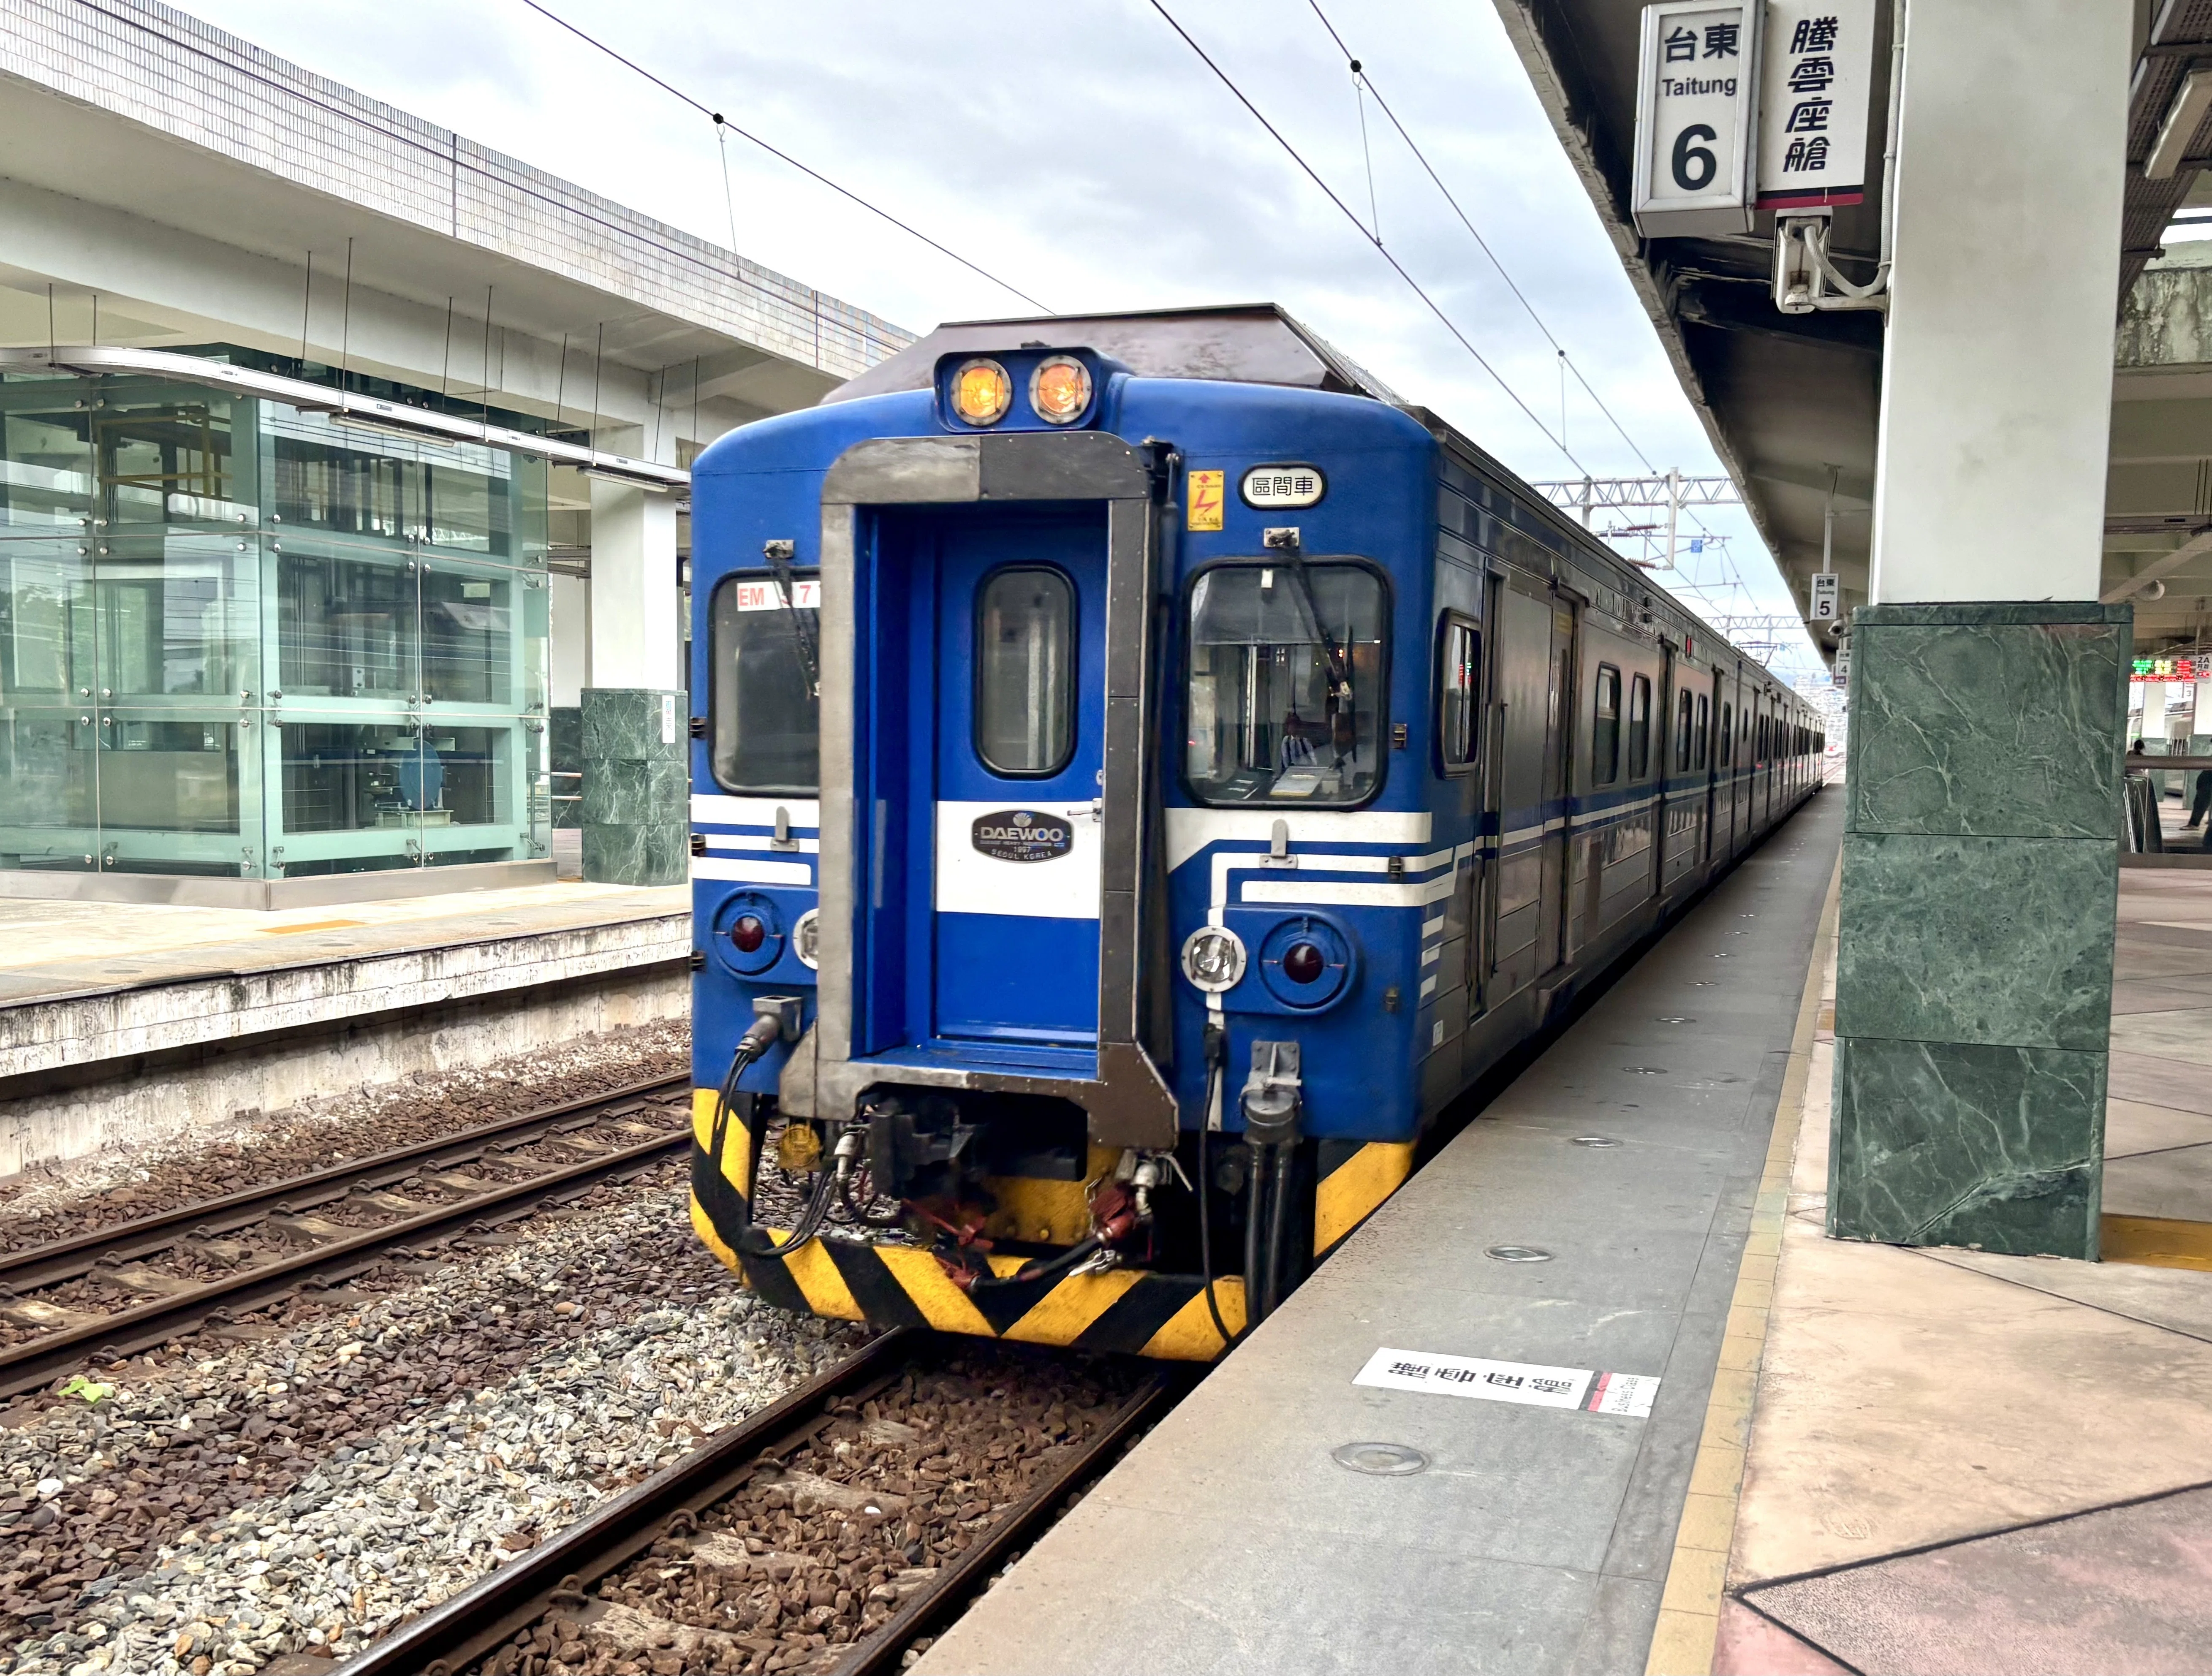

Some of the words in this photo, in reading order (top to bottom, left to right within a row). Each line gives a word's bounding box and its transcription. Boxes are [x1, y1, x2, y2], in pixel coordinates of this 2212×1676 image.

[1664, 23, 1740, 63] 台東
[1662, 77, 1737, 97] Taitung
[1783, 16, 1838, 173] 騰雲座艙
[1671, 124, 1717, 191] 6
[1252, 476, 1314, 496] 區間車
[1817, 579, 1834, 587] 台東
[739, 587, 764, 606] EM
[1819, 600, 1830, 616] 5
[1840, 665, 1848, 674] 4
[980, 826, 1064, 842] DAEWOO
[1024, 850, 1052, 860] KOREA
[1620, 1377, 1639, 1389] Class
